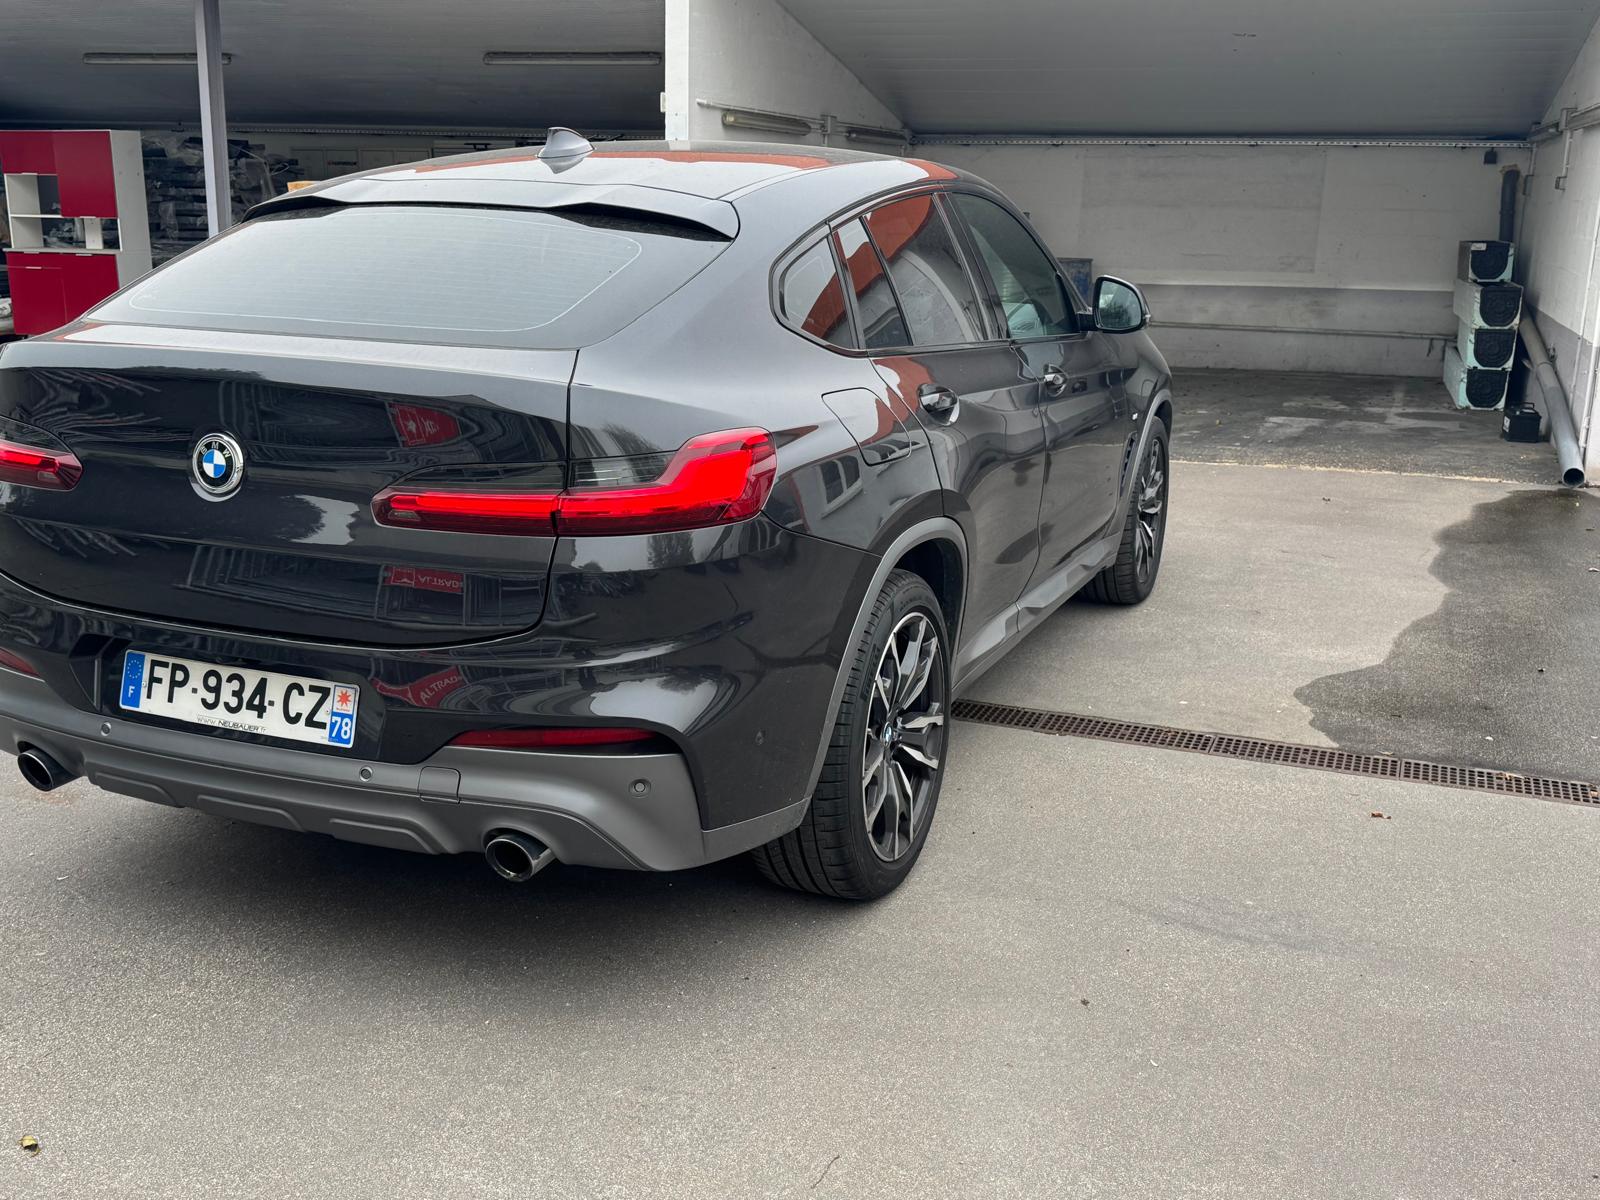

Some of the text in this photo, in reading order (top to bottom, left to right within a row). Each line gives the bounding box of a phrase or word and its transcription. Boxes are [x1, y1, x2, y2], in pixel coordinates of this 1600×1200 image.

[200, 441, 232, 459] BMW
[128, 685, 136, 698] F
[146, 658, 332, 730] FP-934-CZ
[420, 675, 458, 705] ALTRAD
[331, 716, 352, 739] 78
